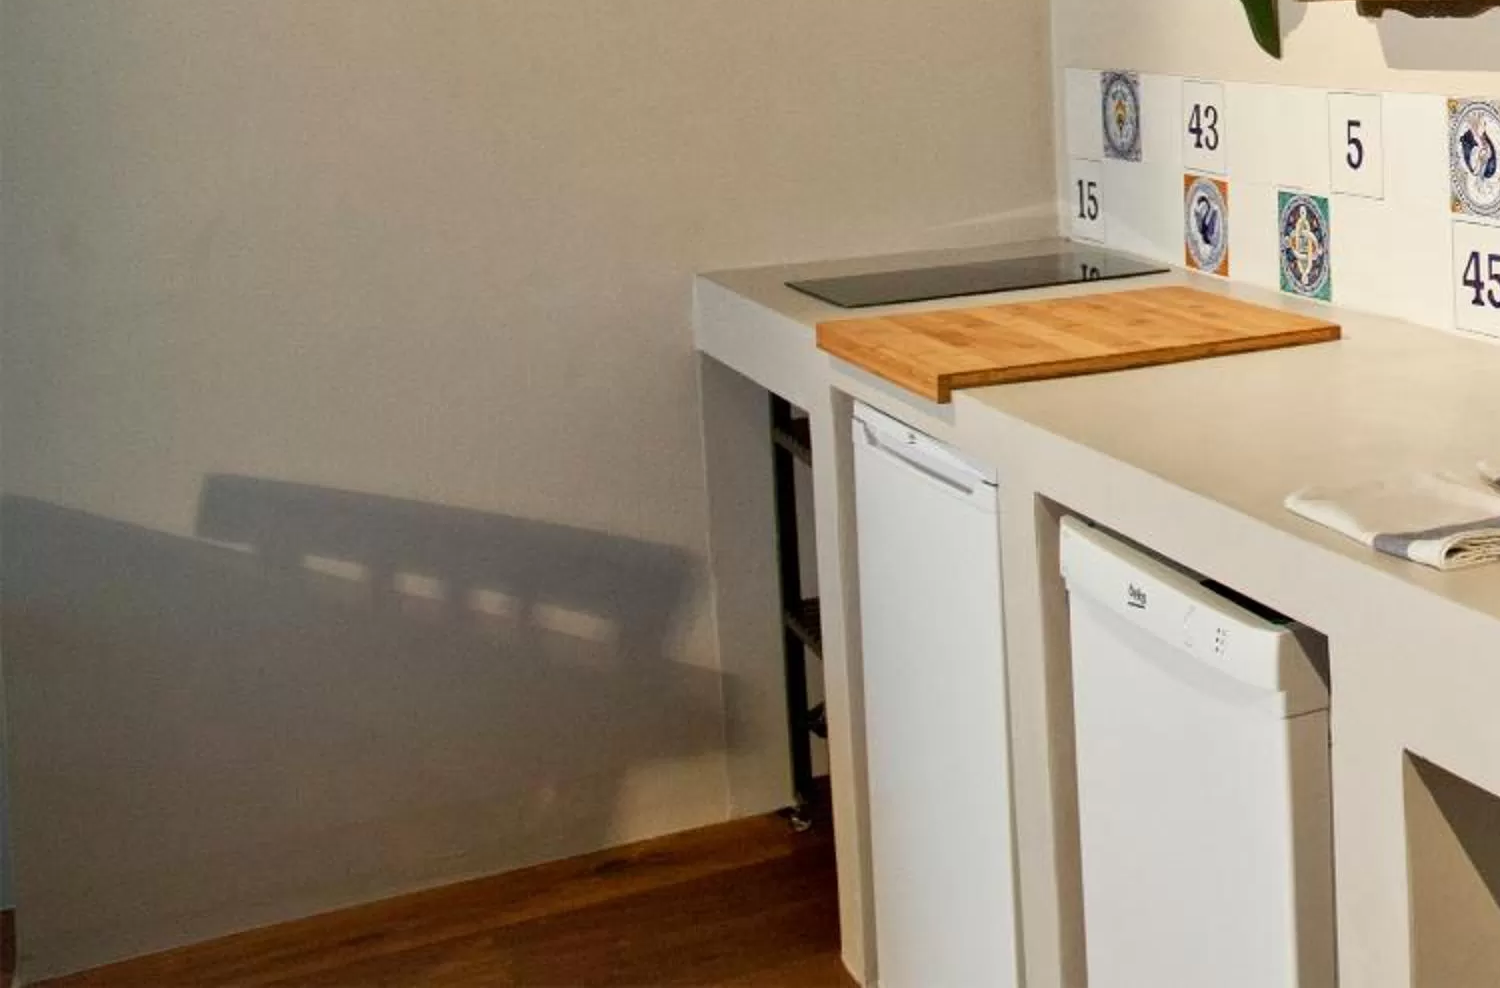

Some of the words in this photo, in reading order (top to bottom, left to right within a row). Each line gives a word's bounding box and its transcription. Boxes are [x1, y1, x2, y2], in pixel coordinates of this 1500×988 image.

[1187, 103, 1219, 151] 43
[1346, 119, 1364, 170] 5
[1076, 178, 1099, 222] 15
